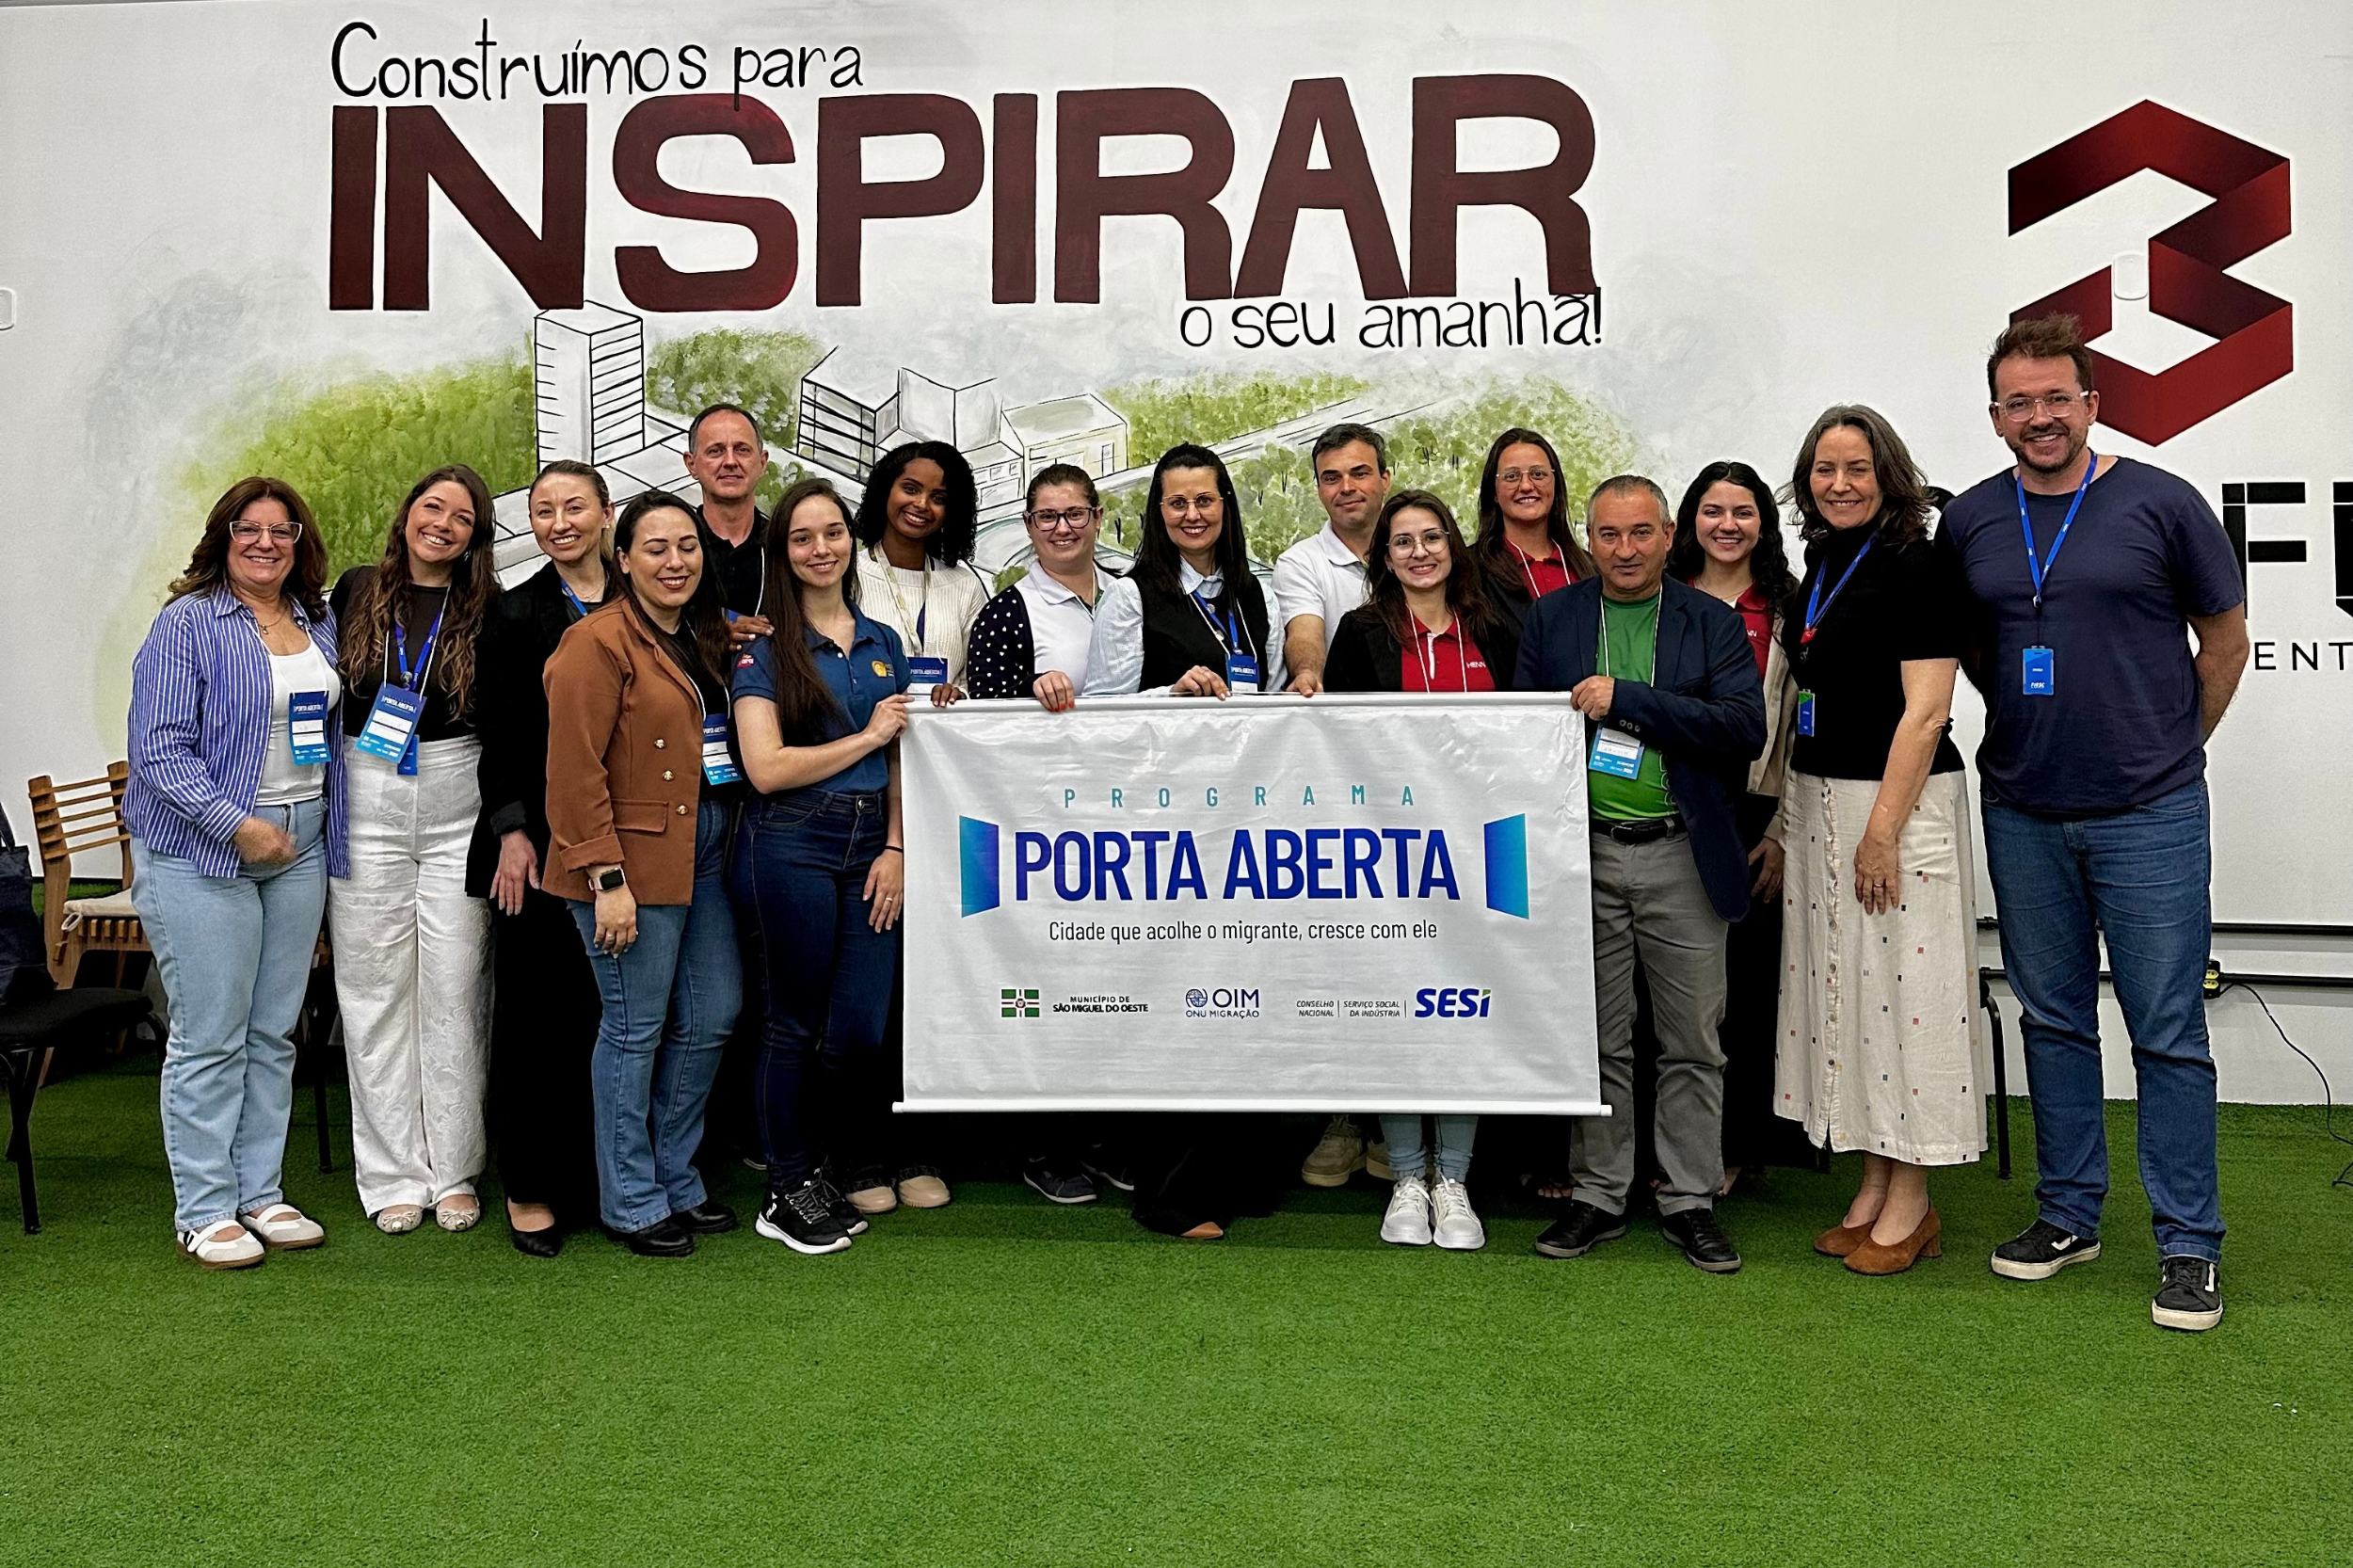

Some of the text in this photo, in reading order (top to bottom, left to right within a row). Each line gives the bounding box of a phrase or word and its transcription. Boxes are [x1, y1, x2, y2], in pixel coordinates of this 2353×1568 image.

[331, 18, 864, 111] Construímos para
[329, 73, 1598, 312] INSPIRAR
[1180, 277, 1602, 349] o seu amanhã!
[1064, 784, 1414, 808] PROGRAMA
[1015, 828, 1461, 902] PORTA ABERTA
[1049, 919, 1437, 945] Cidade que acolhe o migrante, cresce com ele
[1069, 995, 1116, 1003] MUNICÍPIO
[1212, 988, 1259, 1009] OIM
[1296, 1000, 1335, 1008] CONSELHO
[1343, 1000, 1401, 1009] SERVIÇO SOCIAL
[1052, 1003, 1149, 1013] SÃO MIGUEL DO OESTE
[1185, 1009, 1259, 1019] ONU MIGRAÇÃO
[1298, 1009, 1335, 1017] NACIONAL
[1361, 1008, 1401, 1017] INDÚSTRIA
